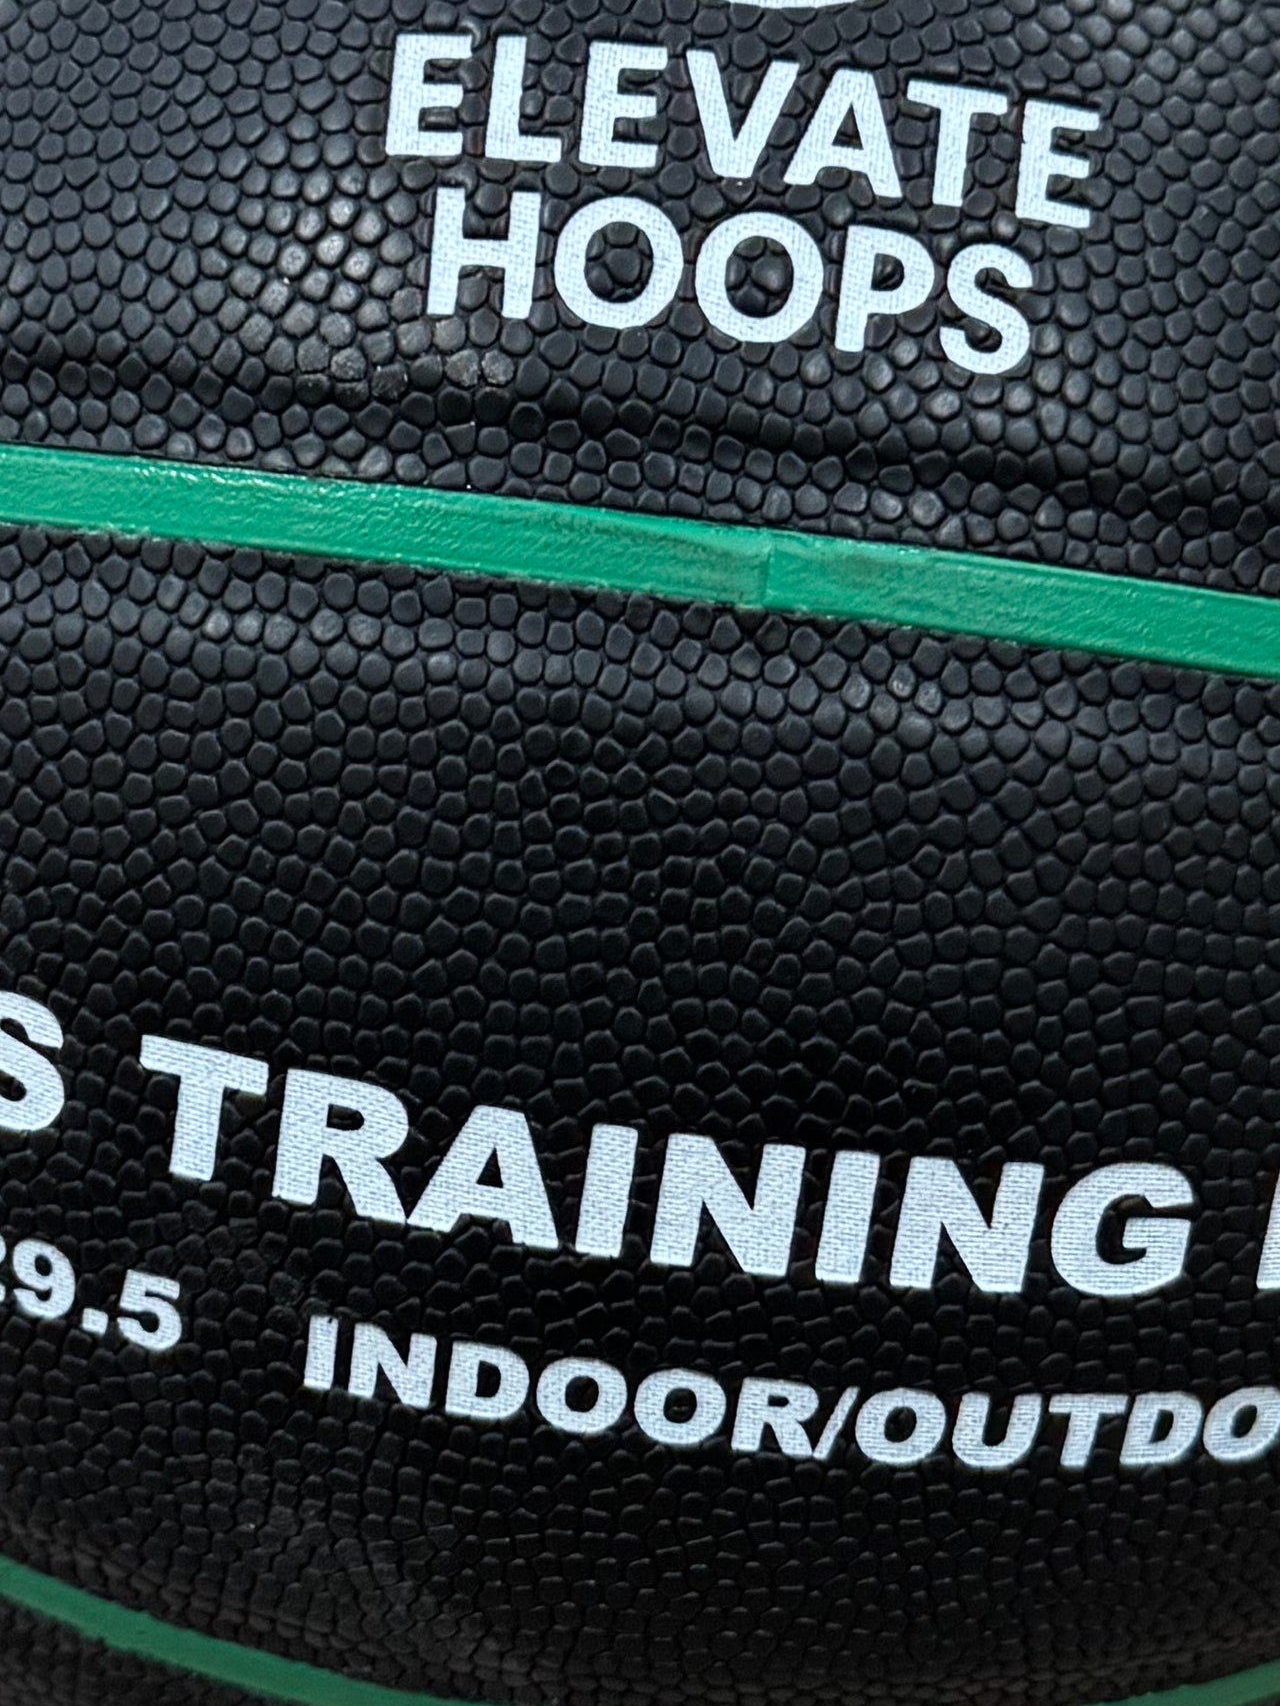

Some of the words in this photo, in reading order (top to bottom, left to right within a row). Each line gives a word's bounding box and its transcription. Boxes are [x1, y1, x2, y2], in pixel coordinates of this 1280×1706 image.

[384, 32, 1103, 231] ELEVATE
[425, 185, 1035, 377] HOOPS
[138, 1033, 1195, 1298] TRAINING
